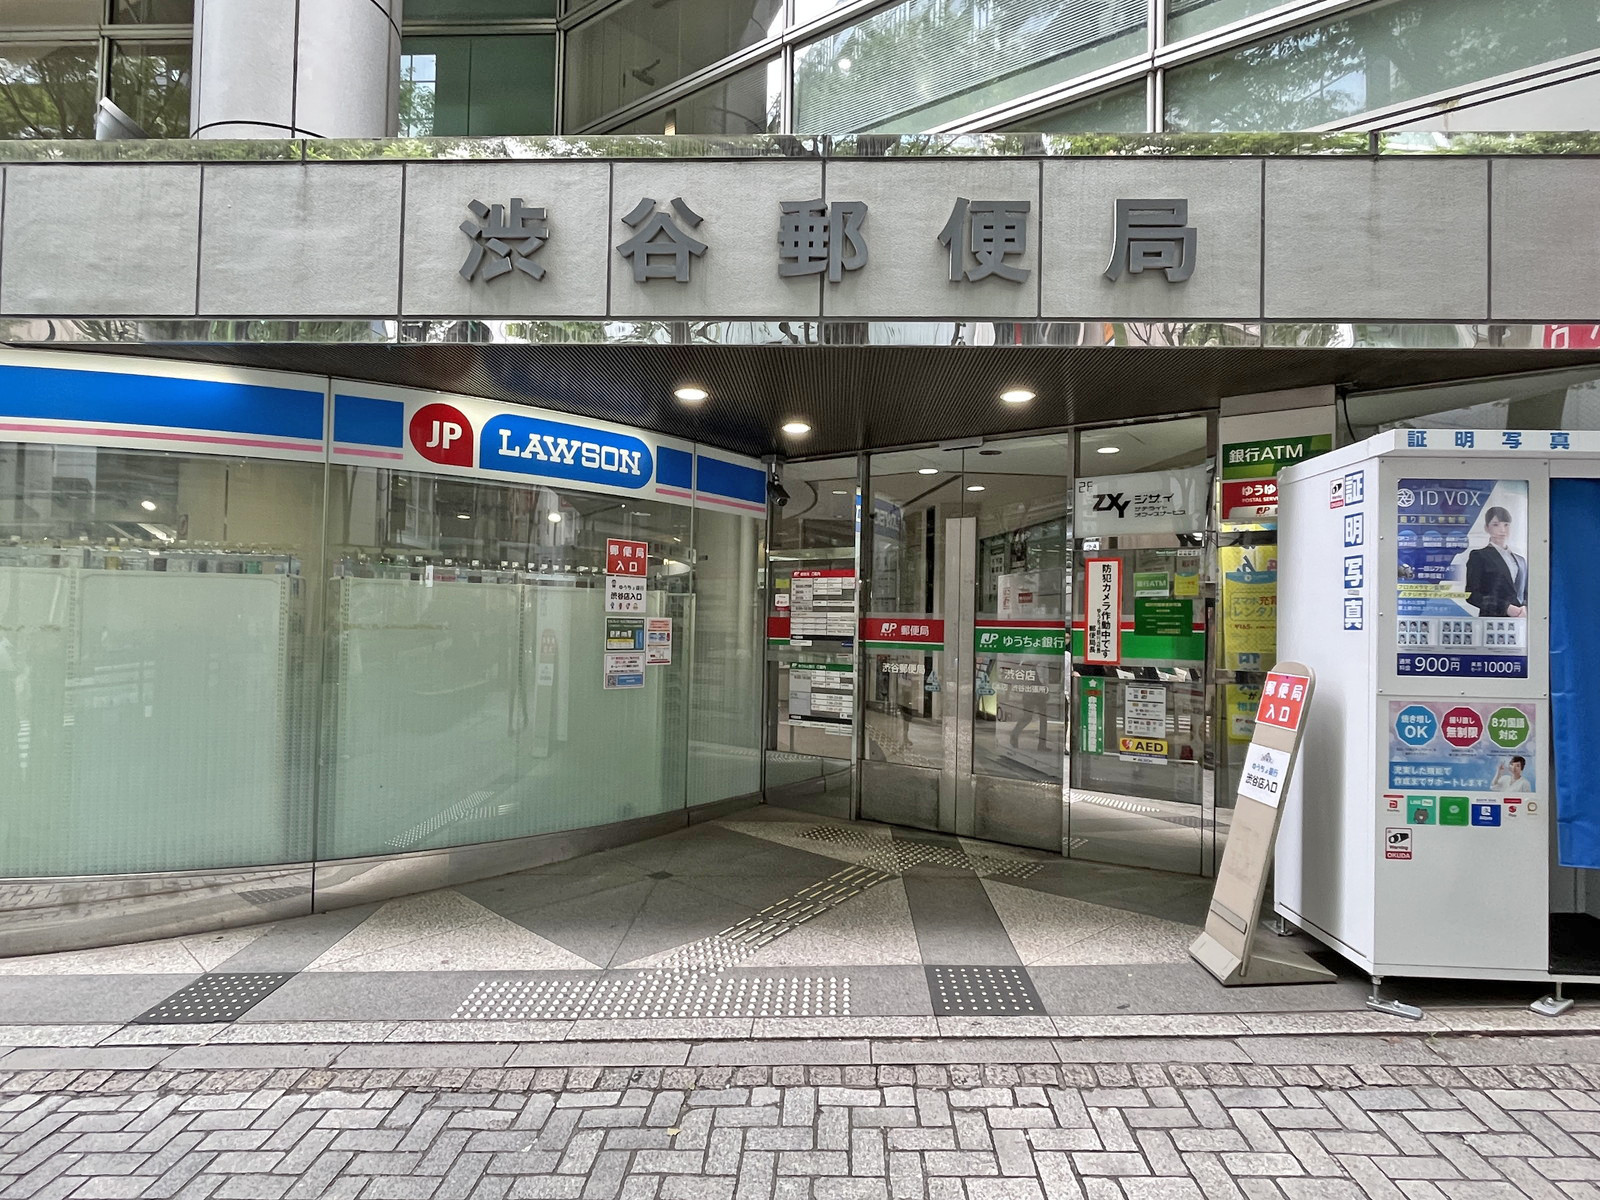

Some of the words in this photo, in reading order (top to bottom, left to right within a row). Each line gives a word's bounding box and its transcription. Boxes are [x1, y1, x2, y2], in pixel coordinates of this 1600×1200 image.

[459, 196, 1199, 283] 渋谷郵便局
[425, 420, 463, 449] JP
[1407, 430, 1570, 450] 証明写真
[498, 428, 642, 476] LAWSON
[1228, 443, 1304, 464] 銀行ATM
[1078, 481, 1093, 493] 2F
[1241, 483, 1278, 497] ゆうゆ
[1092, 492, 1132, 519] ZXY
[1420, 490, 1439, 506] ID
[1444, 490, 1481, 506] VOX
[609, 544, 645, 559] 郵便局
[1344, 471, 1365, 630] 証明写真
[615, 560, 638, 572] 入口
[1101, 563, 1112, 658] 防犯カメラ作動中です
[900, 625, 930, 637] 郵便局
[1002, 636, 1065, 649] ゆうちょ銀行
[882, 663, 926, 675] 渋谷郵便局
[1414, 656, 1461, 673] 900円
[1483, 661, 1522, 673] 1000円
[1004, 669, 1037, 681] 渋谷店
[1264, 680, 1304, 702] 郵便局
[1265, 703, 1291, 723] 入口
[1404, 725, 1429, 739] OK
[1446, 726, 1479, 739] 無制限
[1498, 729, 1519, 741] 対応
[1135, 741, 1164, 753] AED
[1245, 773, 1279, 794] 渋谷店入口
